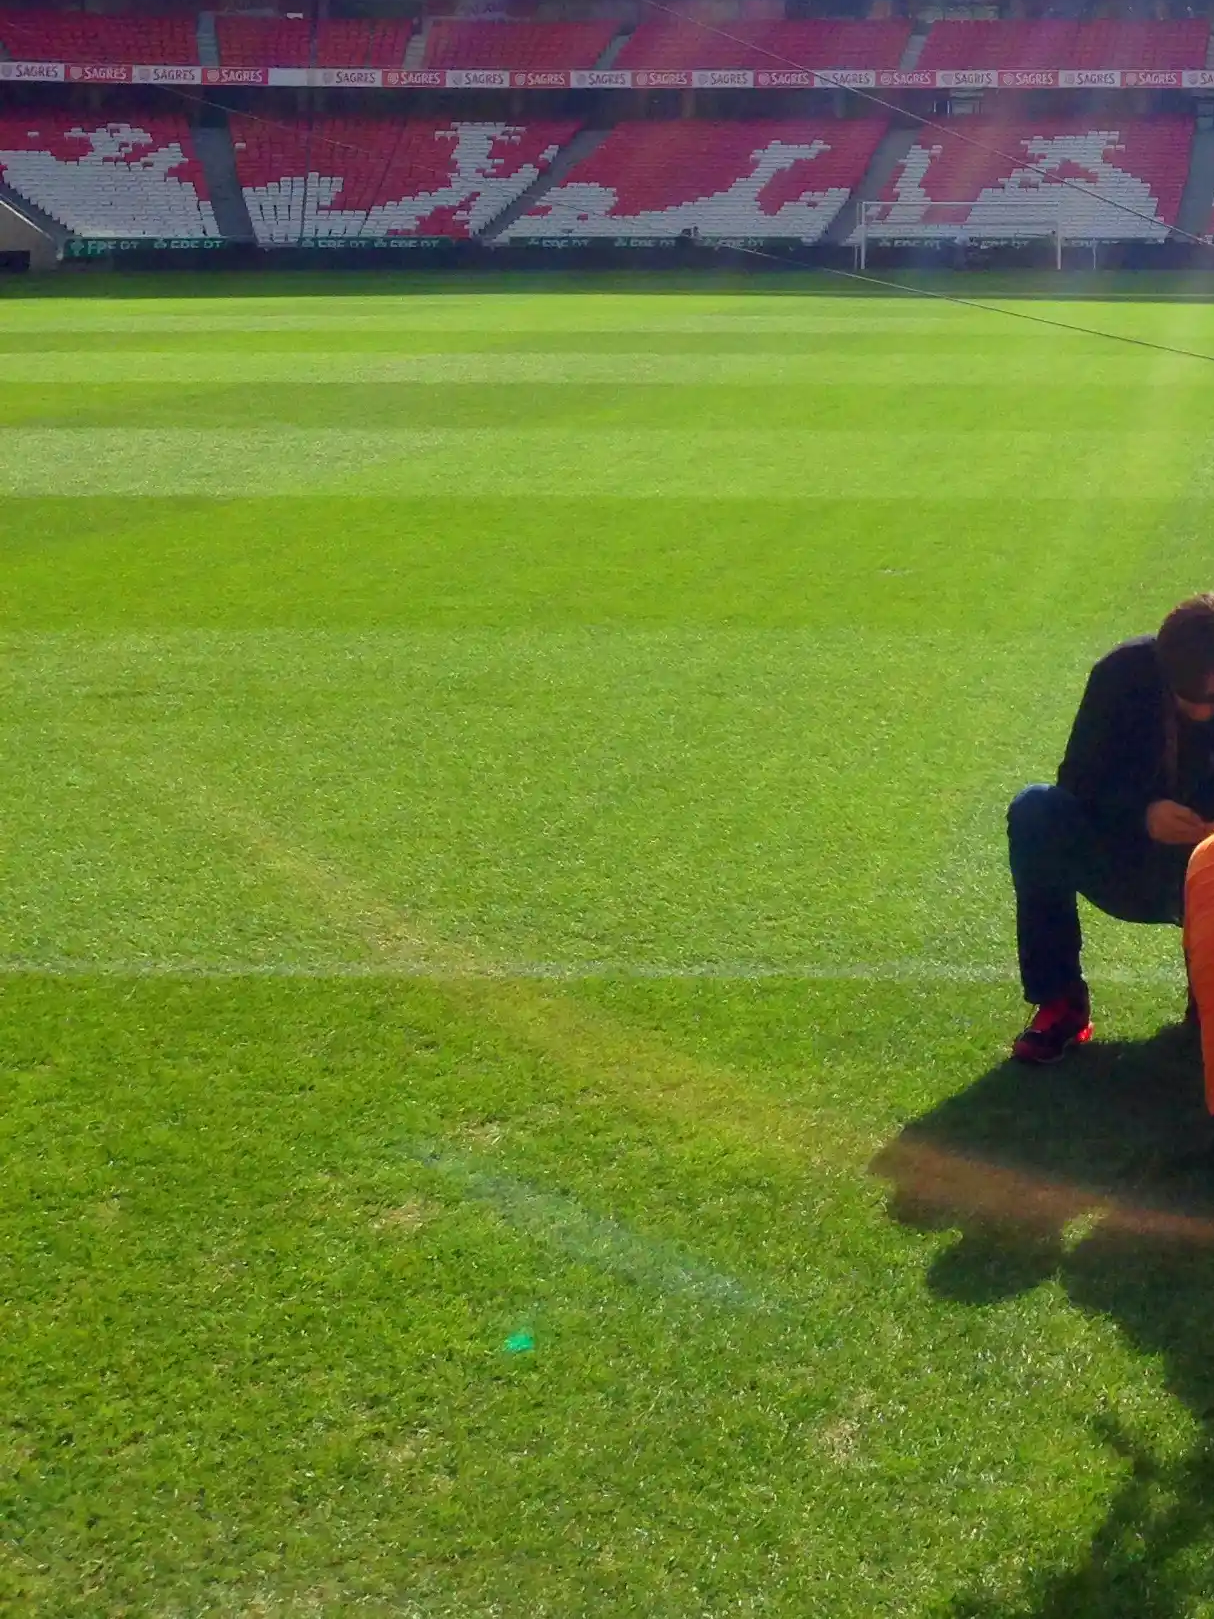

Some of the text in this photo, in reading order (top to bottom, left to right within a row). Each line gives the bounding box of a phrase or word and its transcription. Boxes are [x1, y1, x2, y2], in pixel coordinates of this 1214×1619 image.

[16, 64, 58, 78] SAGRES
[84, 66, 126, 80] SAGRES
[153, 67, 195, 81] SAGRES
[220, 69, 262, 82] SAGRES
[336, 70, 376, 84] SAGRES
[401, 71, 440, 85] SAGRES
[465, 72, 503, 86] SAGRES
[526, 72, 565, 86] SAGRES
[588, 72, 626, 86] SAGRES
[649, 72, 687, 85] SAGRES
[710, 72, 748, 85] SAGRES
[770, 72, 809, 85] SAGRES
[832, 71, 870, 85] SAGRES
[891, 72, 931, 85] SAGRES
[955, 72, 992, 85] SAGRES
[1015, 72, 1054, 85] SAGRES
[1075, 72, 1115, 85] SAGRES
[1138, 72, 1177, 85] SAGRES
